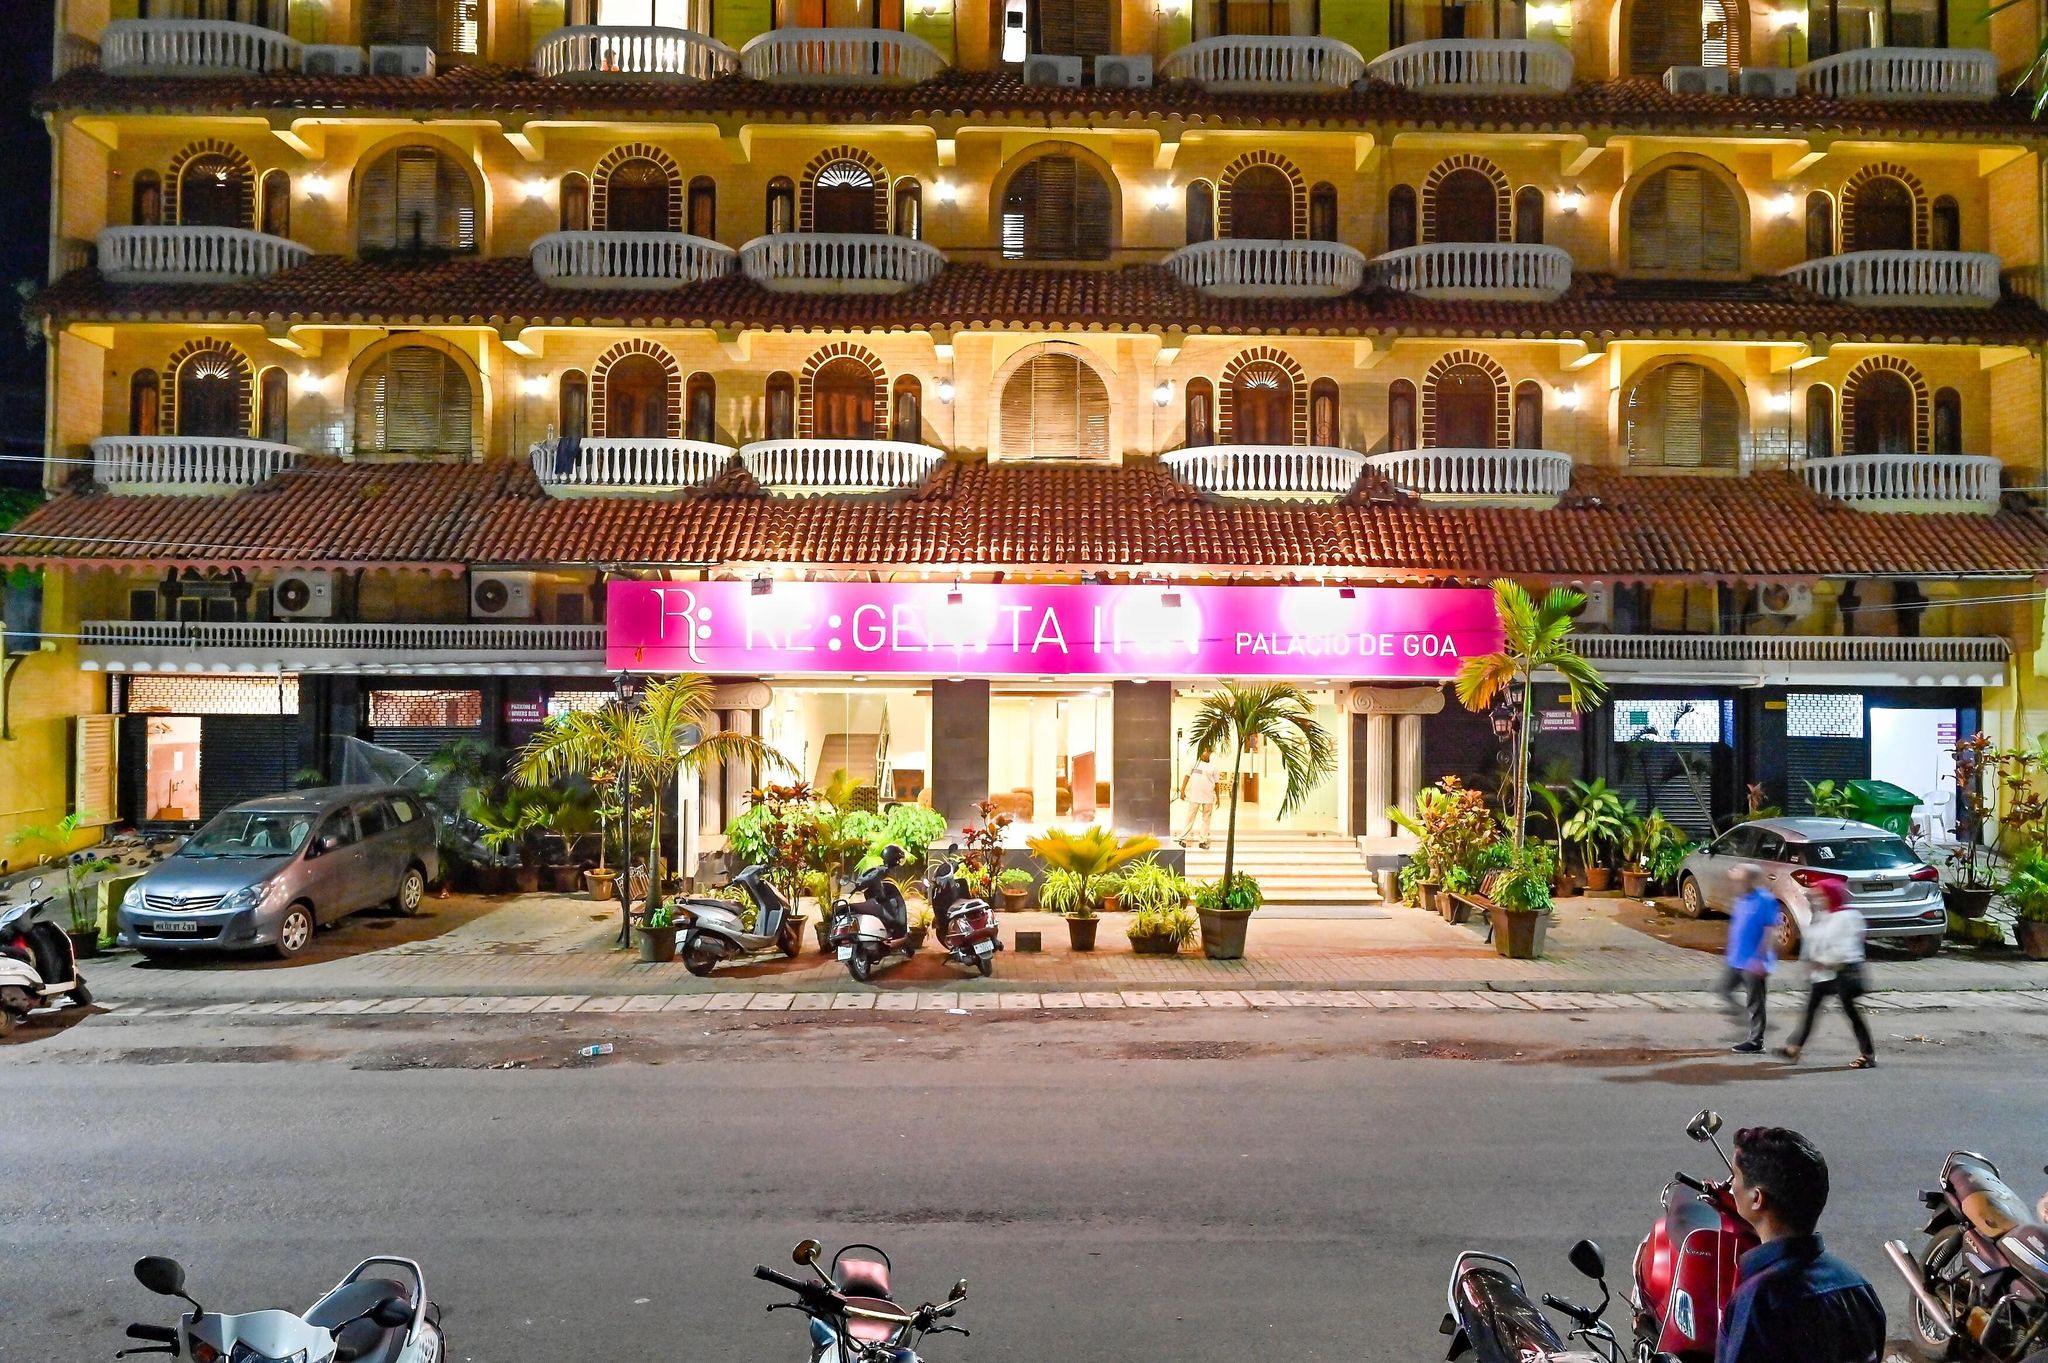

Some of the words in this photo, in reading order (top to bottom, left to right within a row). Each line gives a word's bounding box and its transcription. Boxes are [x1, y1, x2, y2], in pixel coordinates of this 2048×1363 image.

[1235, 632, 1351, 656] PALACIO
[1360, 634, 1394, 656] DE
[1403, 634, 1458, 657] GOA
